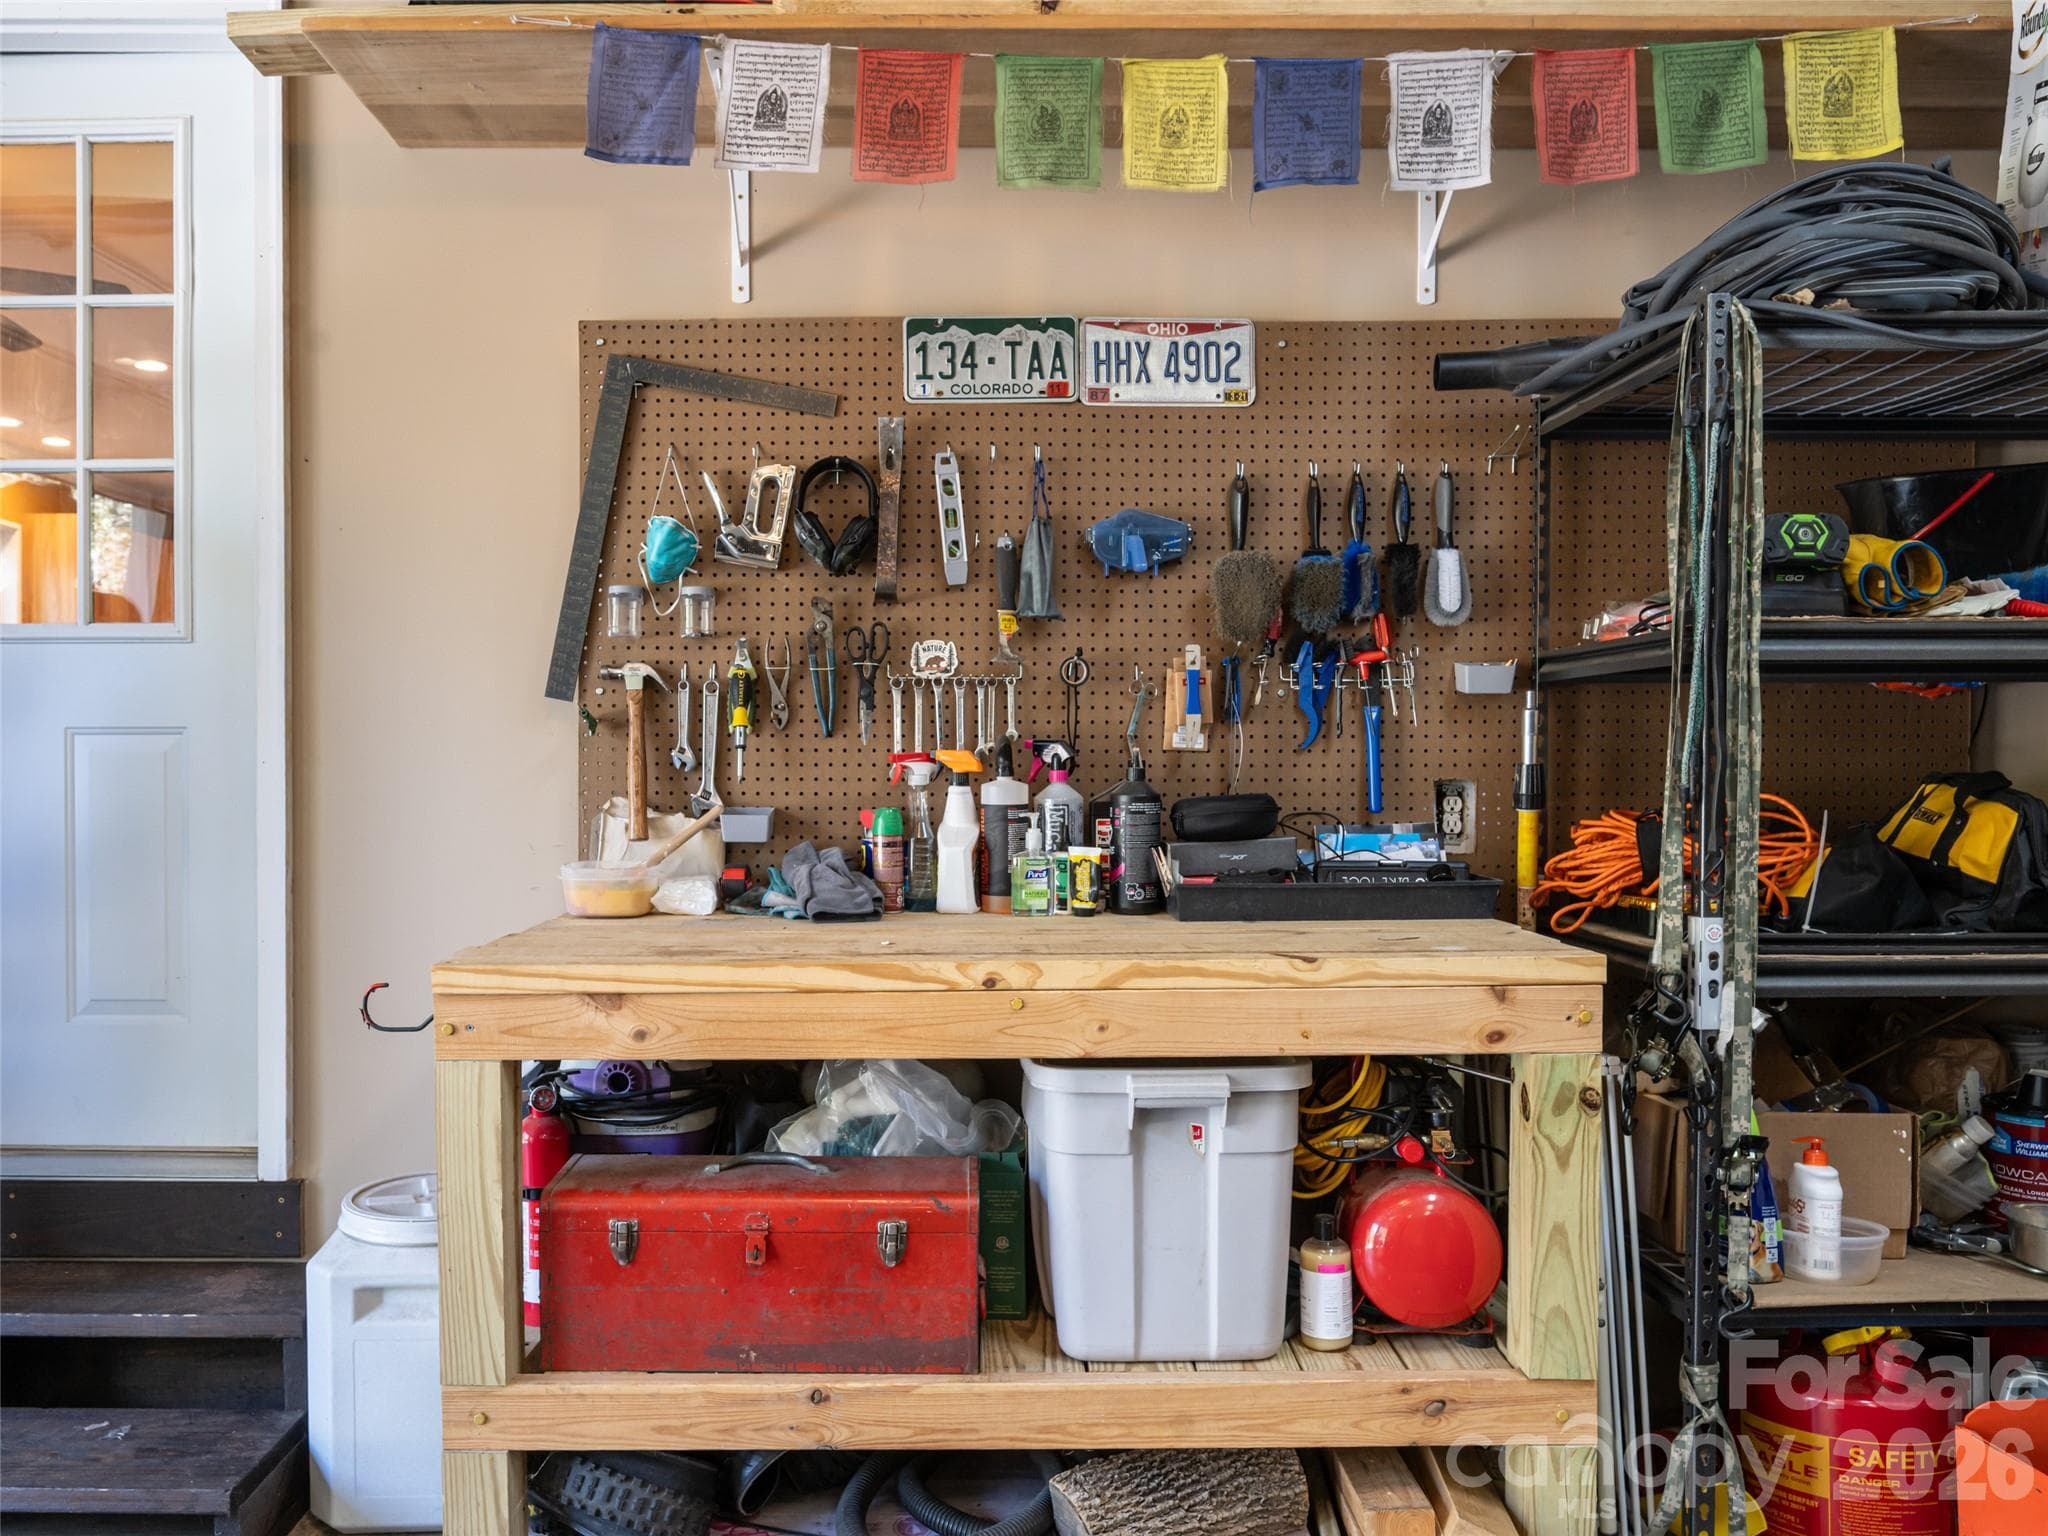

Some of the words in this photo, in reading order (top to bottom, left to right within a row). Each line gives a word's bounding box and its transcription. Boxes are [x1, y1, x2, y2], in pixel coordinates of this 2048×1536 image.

[1147, 323, 1188, 335] OHIO
[1093, 341, 1151, 383] HHX
[1164, 341, 1241, 383] 4902
[950, 383, 1033, 395] COLORADO
[1090, 391, 1108, 401] 87
[1776, 574, 1804, 582] EGO
[922, 644, 947, 654] NATURE
[1027, 869, 1048, 879] Purell
[1849, 1445, 1941, 1469] SAFETY
[1839, 1475, 1900, 1487] DANGER
